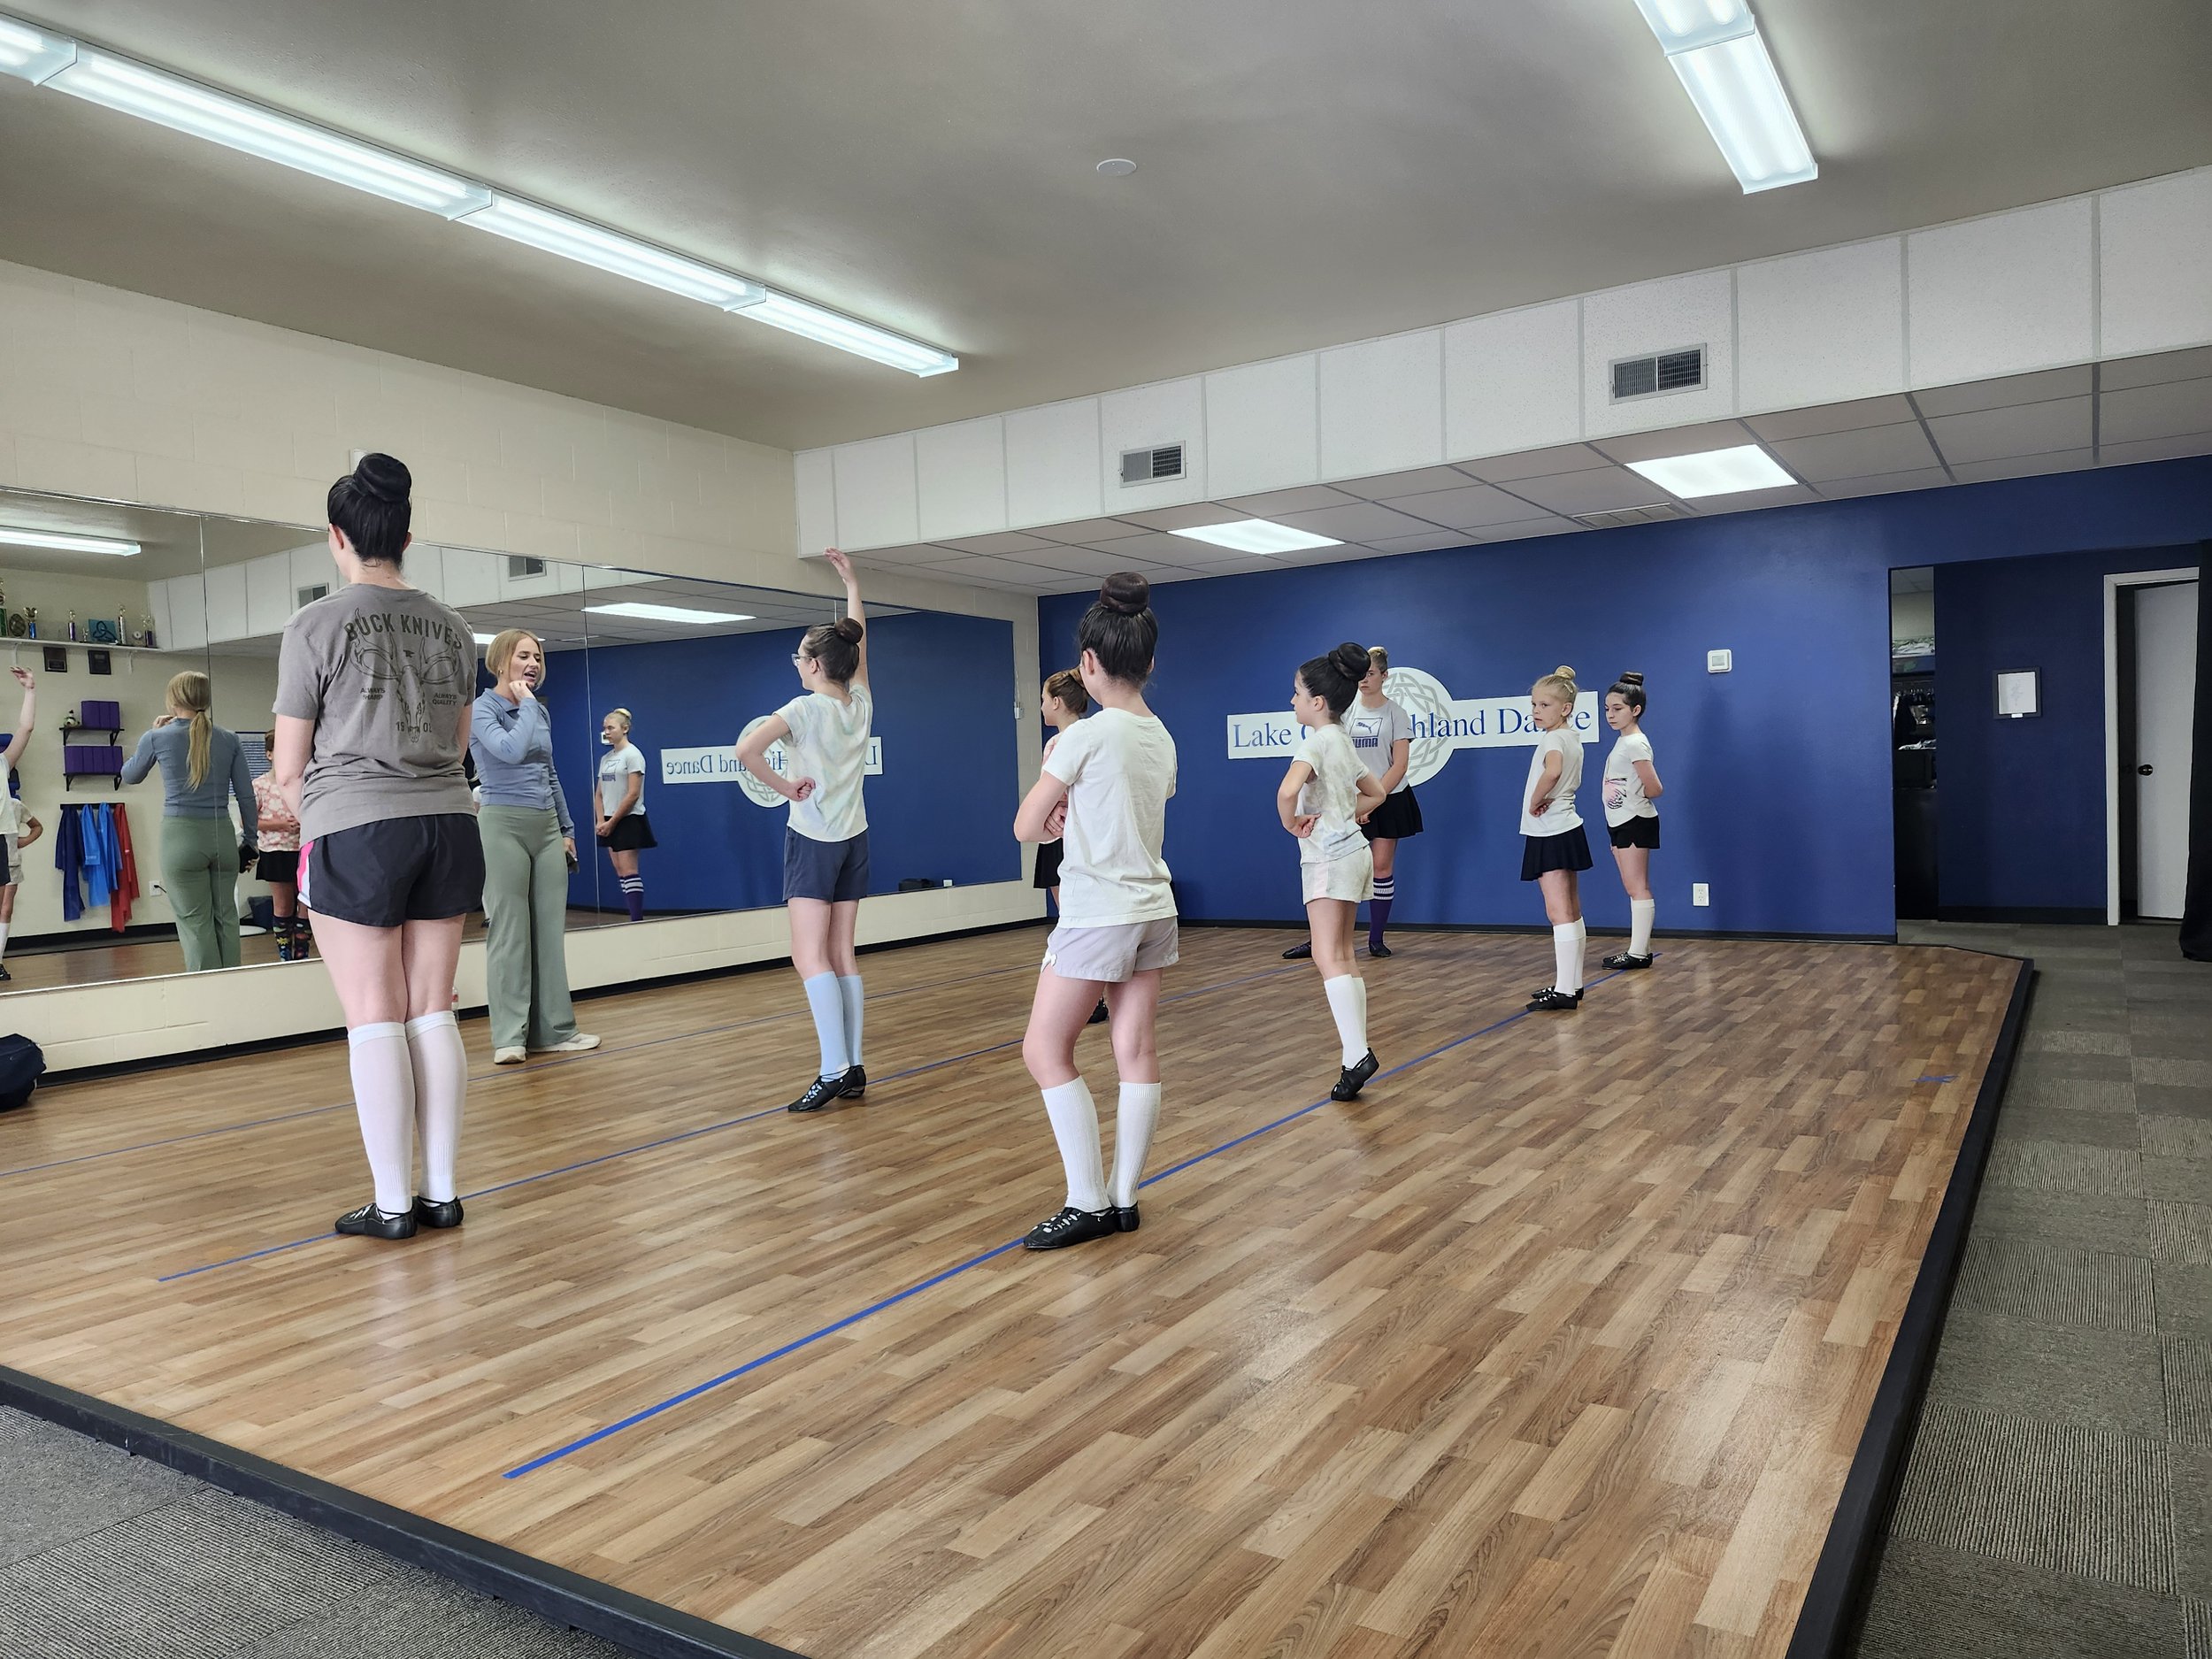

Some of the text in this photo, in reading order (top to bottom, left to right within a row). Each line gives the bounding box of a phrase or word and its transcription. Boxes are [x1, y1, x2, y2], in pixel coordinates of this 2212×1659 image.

[343, 612, 463, 650] BUCK KNIVES
[1233, 722, 1293, 749] Lake
[1409, 710, 1486, 739] hland
[1498, 708, 1592, 735] Dae
